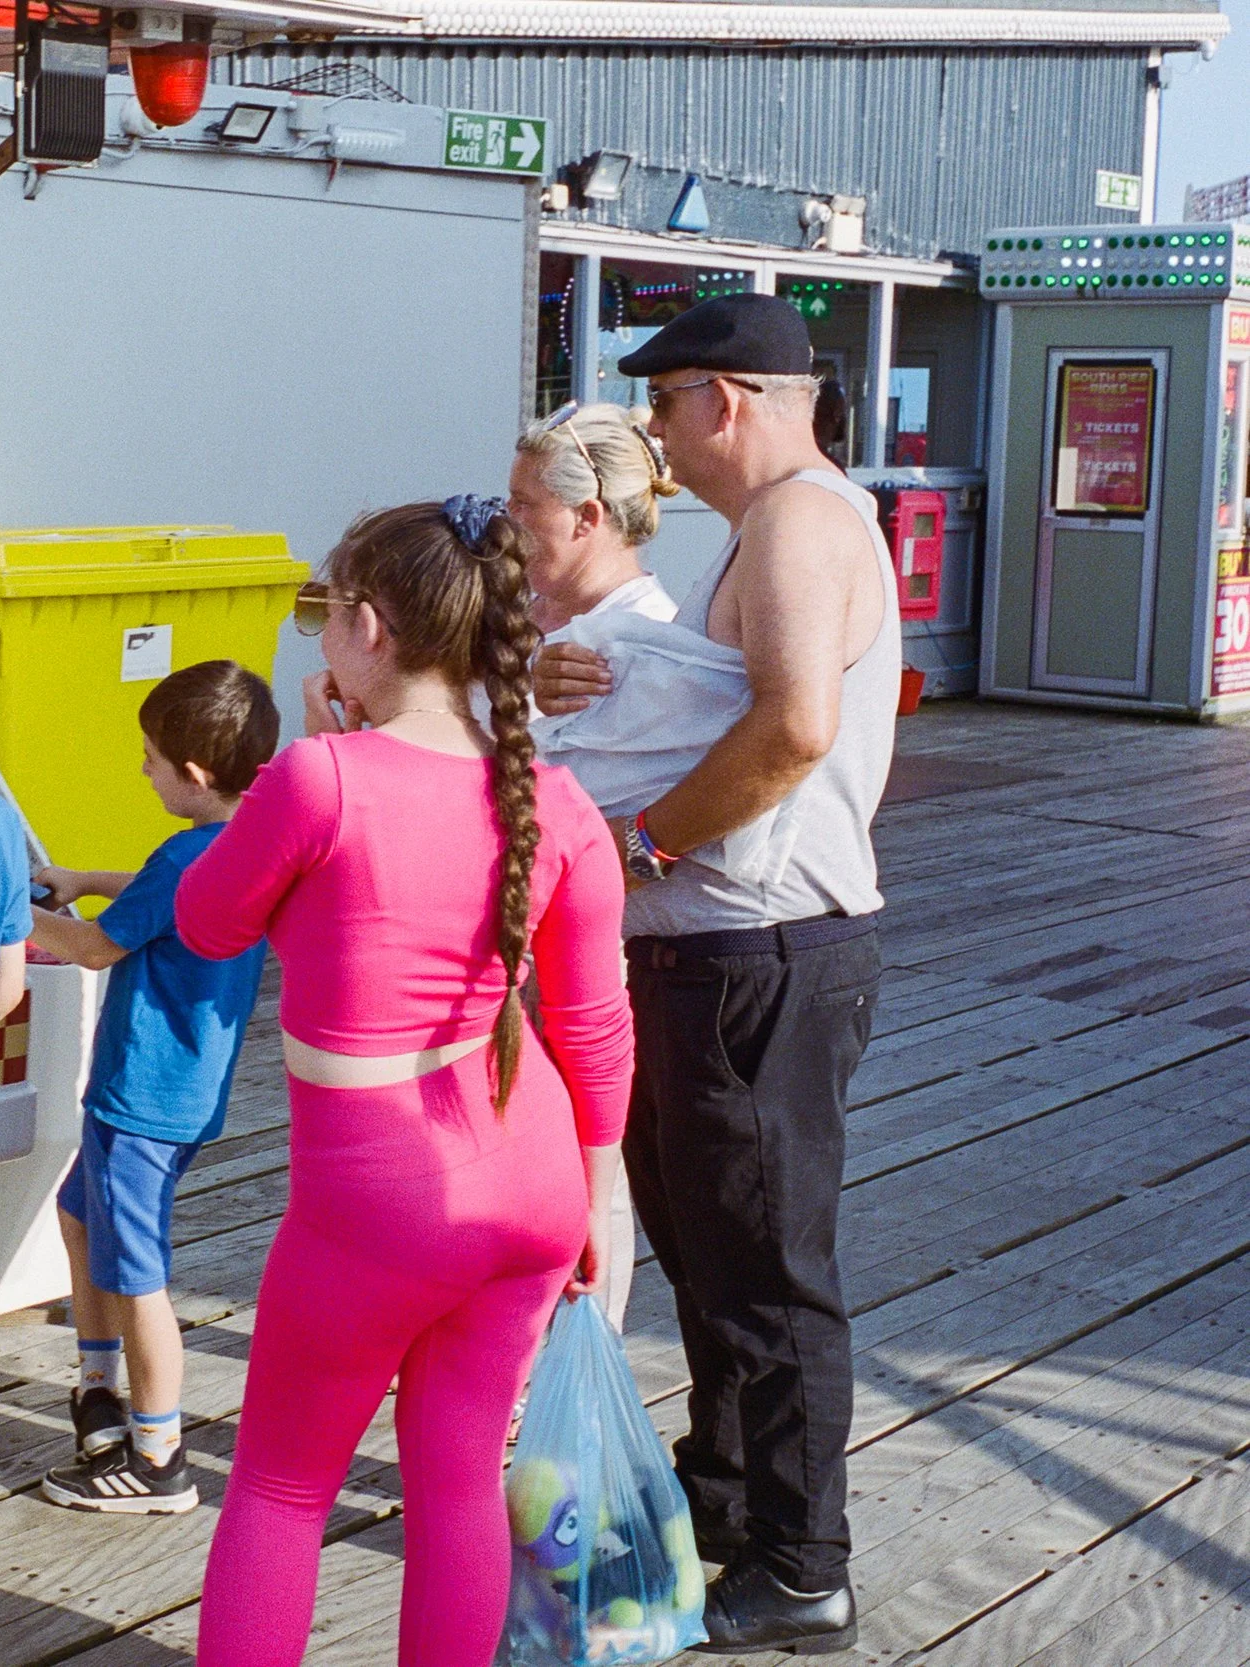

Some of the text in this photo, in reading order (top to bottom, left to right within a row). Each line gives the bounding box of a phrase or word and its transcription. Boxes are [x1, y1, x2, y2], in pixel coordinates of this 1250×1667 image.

[452, 116, 484, 141] Fire
[450, 141, 481, 164] exit
[1071, 372, 1117, 383] SOUTH
[1085, 422, 1139, 433] TICKETS
[1083, 460, 1137, 472] TICKETS
